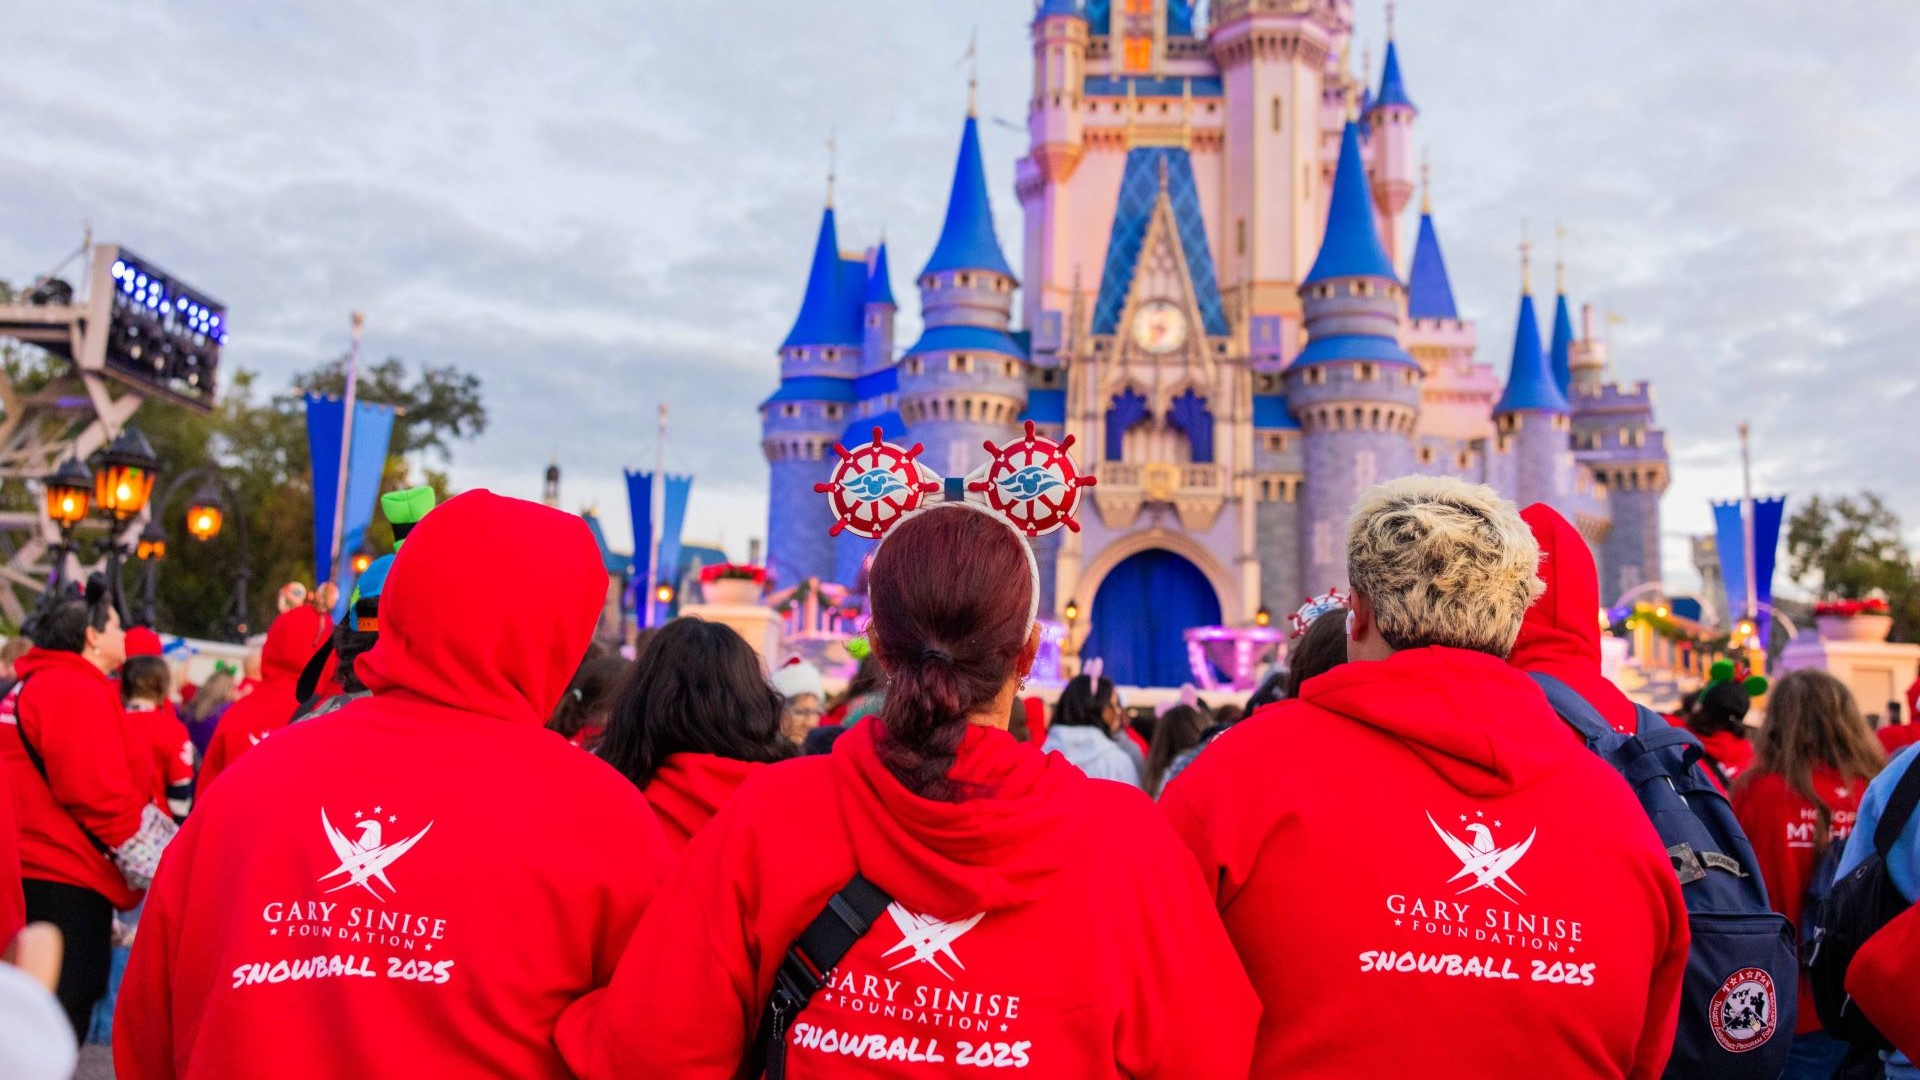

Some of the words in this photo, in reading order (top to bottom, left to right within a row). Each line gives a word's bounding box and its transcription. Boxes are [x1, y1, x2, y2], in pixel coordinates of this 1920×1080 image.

[262, 900, 337, 923] GARY
[348, 907, 447, 940] SINISE
[1386, 894, 1470, 923] GARY
[1485, 908, 1582, 942] SINISE
[288, 924, 414, 950] FOUNDATION
[1412, 920, 1558, 953] FOUNDATION
[232, 954, 377, 989] SNOWBALL
[387, 957, 454, 984] 2025
[1359, 950, 1520, 980] SNOWBALL
[1531, 959, 1596, 987] 2025
[839, 995, 989, 1032] FOUNDATION
[913, 985, 1020, 1019] SINISE
[793, 1022, 945, 1063] SNOWBALL
[955, 1040, 1032, 1068] 2025
[1736, 1037, 1763, 1050] PROGRAM
